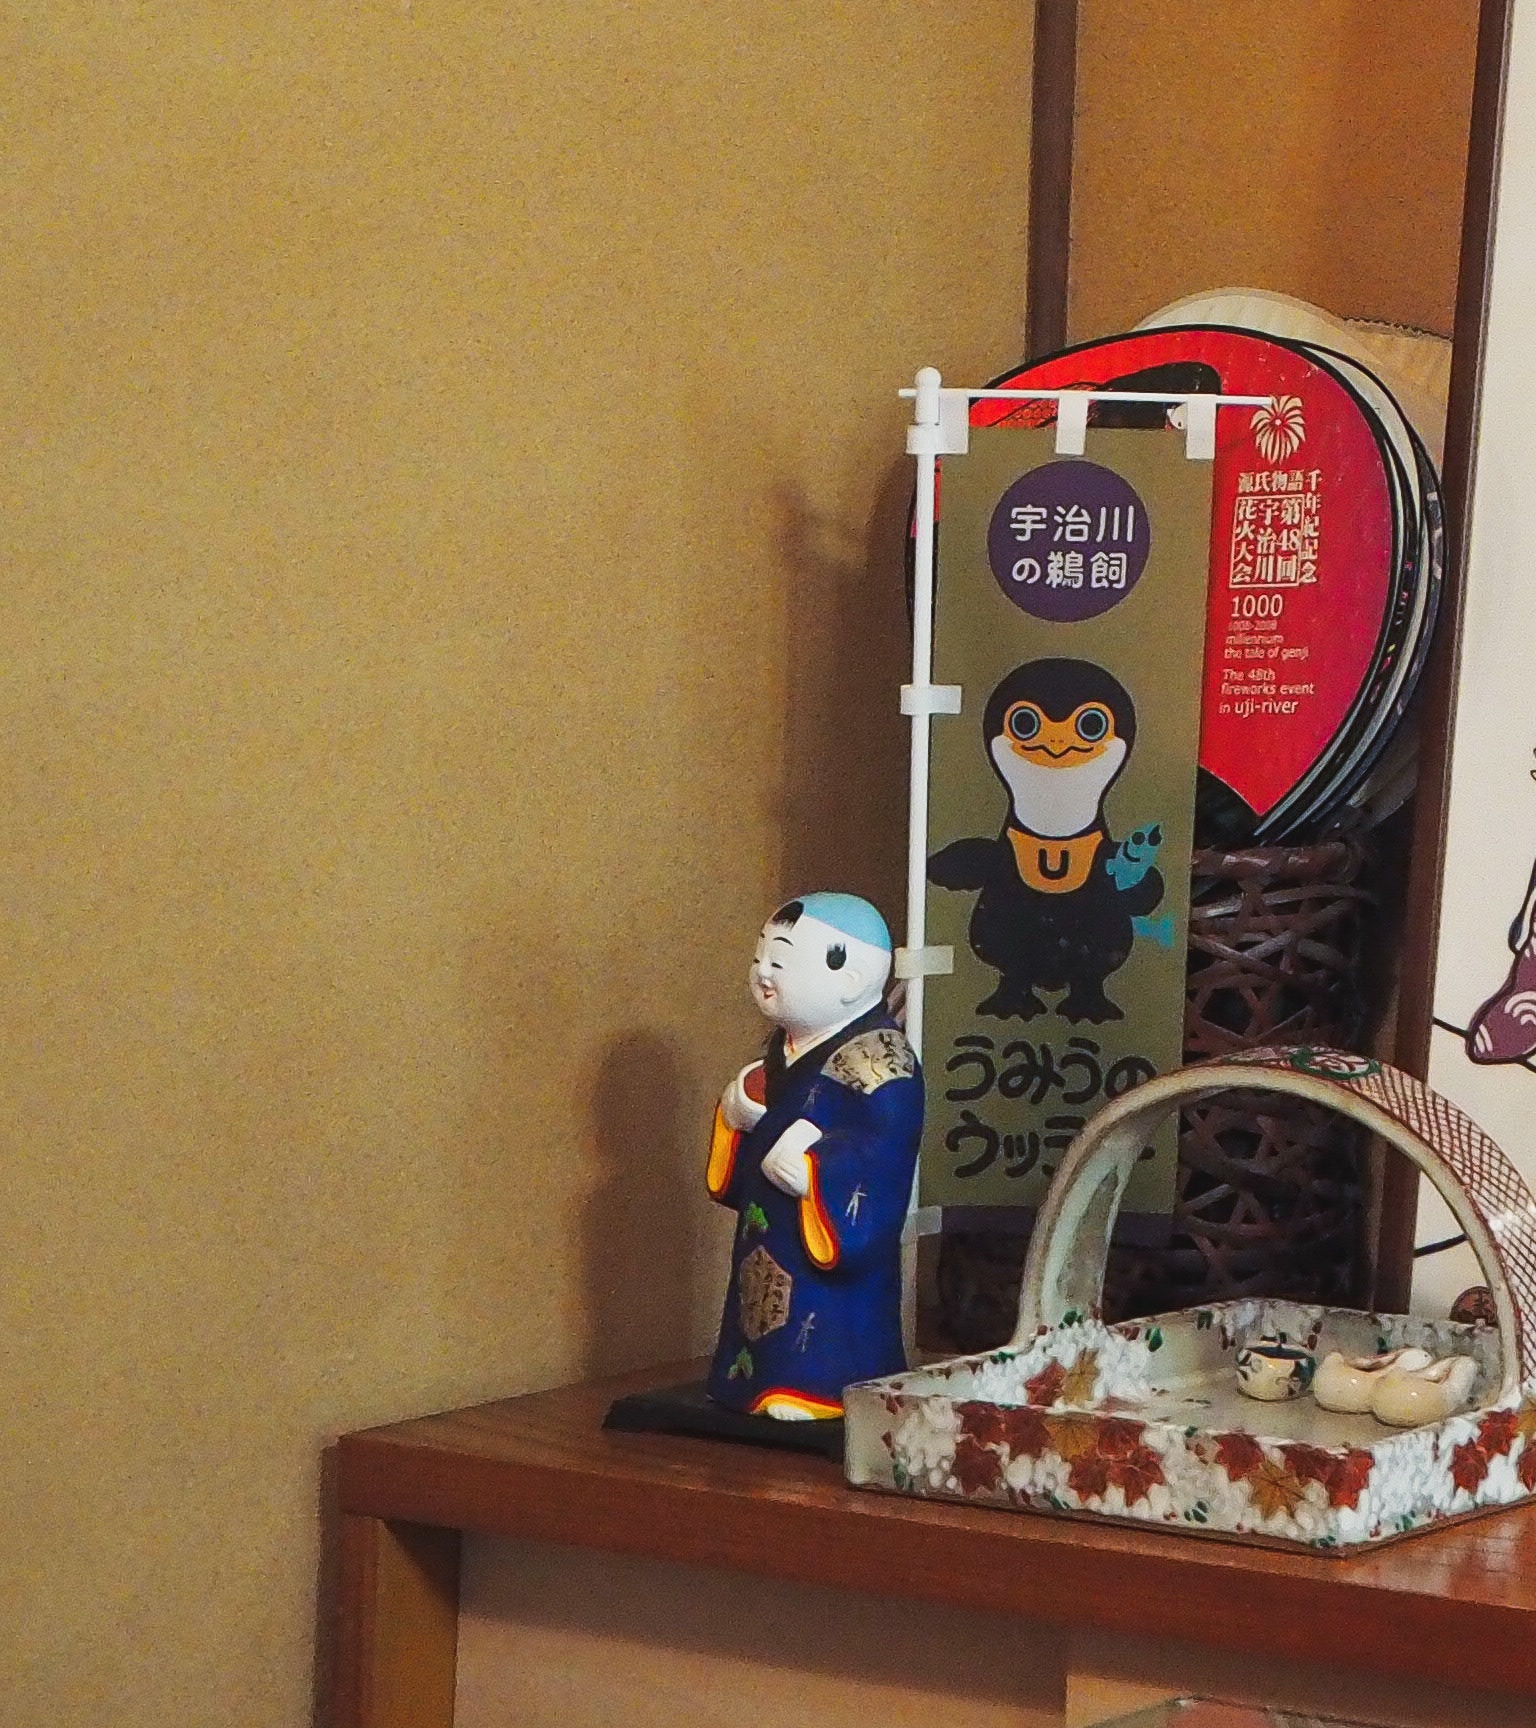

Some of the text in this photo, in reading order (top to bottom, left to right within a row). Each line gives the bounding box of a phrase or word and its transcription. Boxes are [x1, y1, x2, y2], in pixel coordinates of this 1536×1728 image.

[1010, 504, 1135, 542] 宇治川
[1232, 498, 1257, 583] 花火大会
[1252, 499, 1281, 583] 宇治川
[1012, 550, 1128, 589] の鵜飼
[1231, 594, 1283, 617] 1000
[1224, 647, 1243, 659] the
[1267, 646, 1280, 658] of
[1223, 669, 1245, 681] The
[1221, 683, 1314, 695] fireworks event
[1219, 698, 1299, 718] in uji-river
